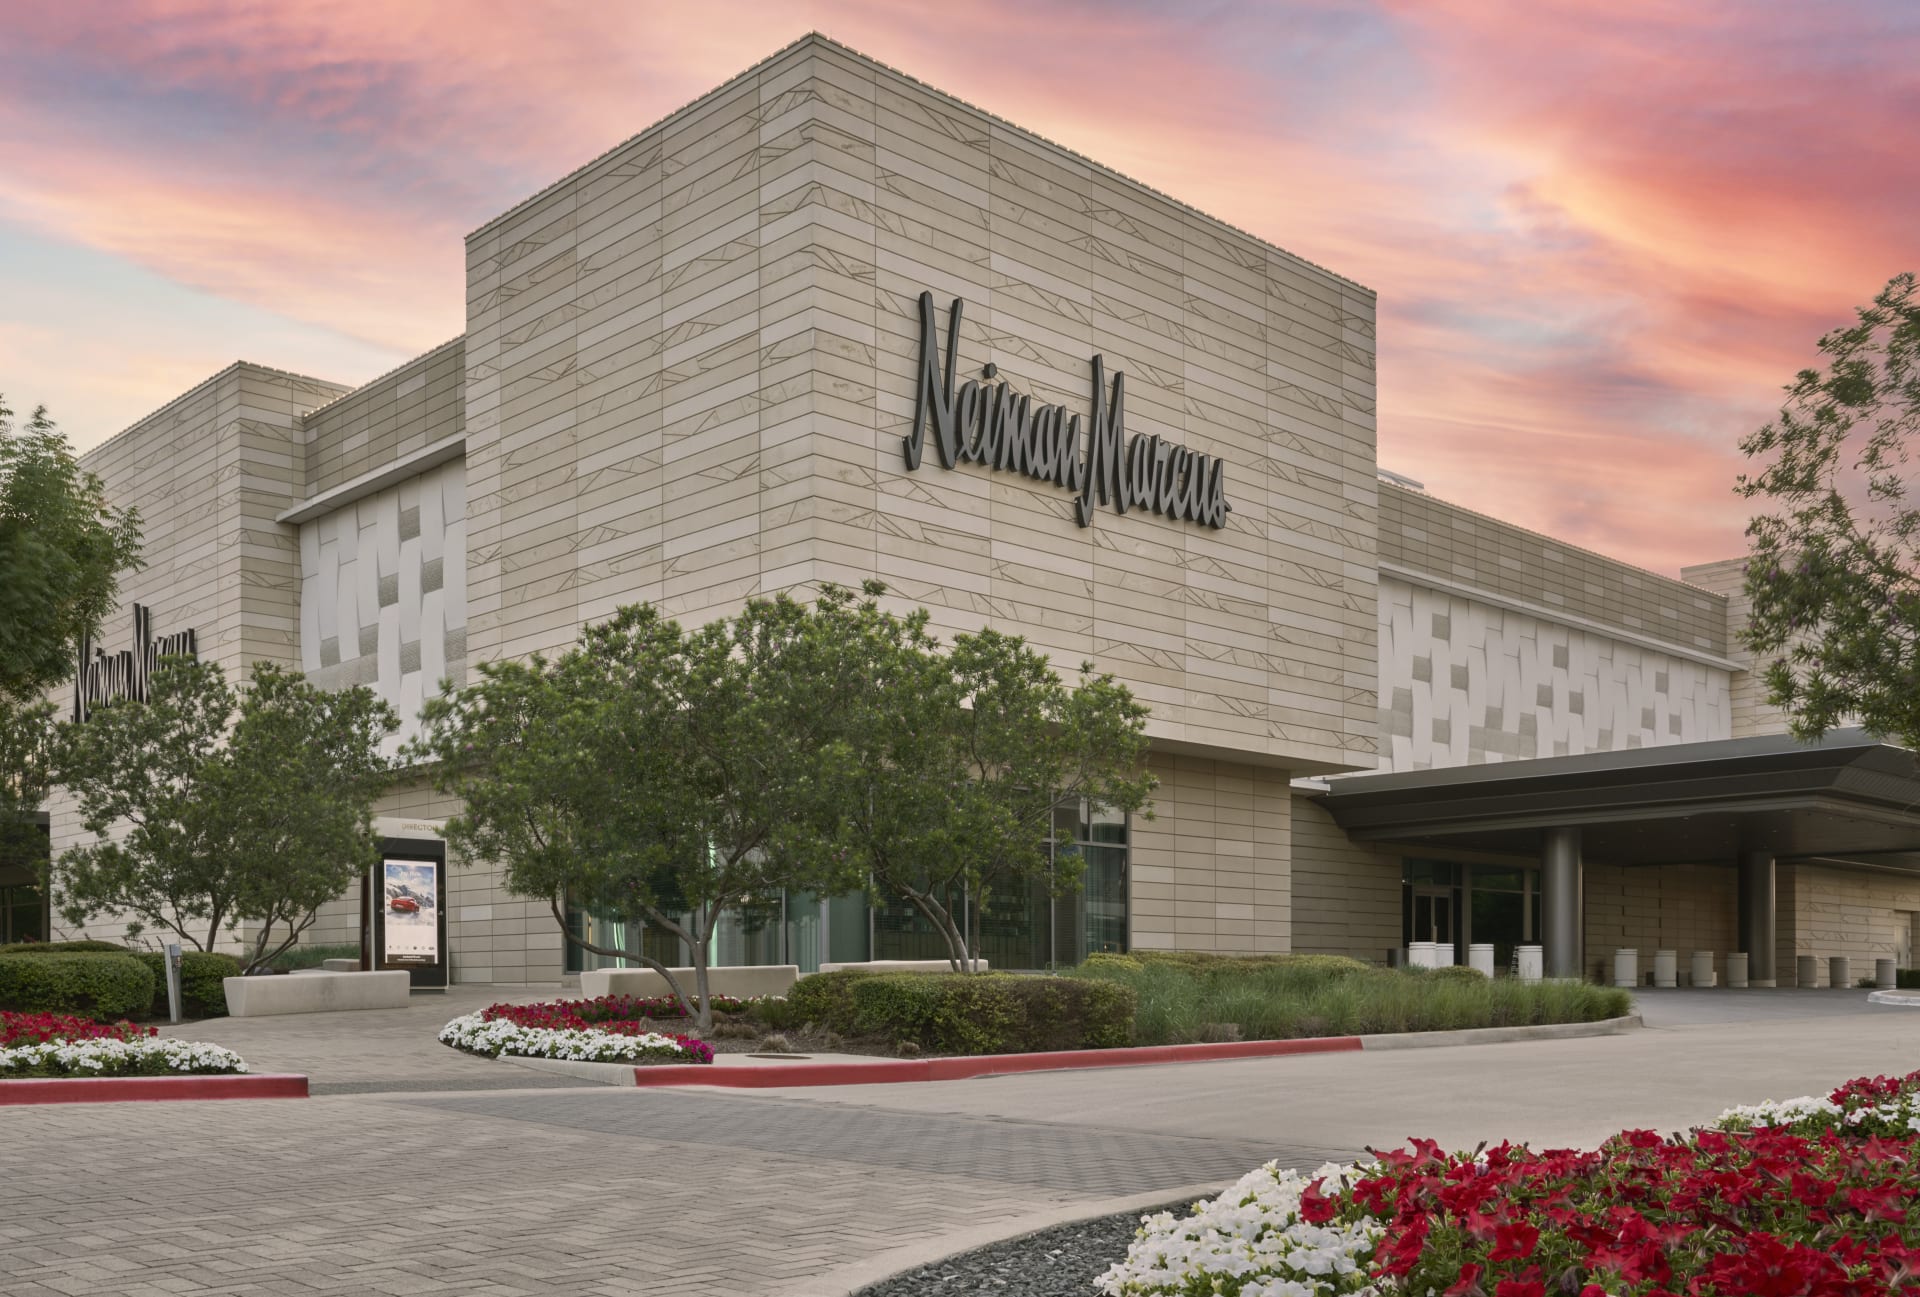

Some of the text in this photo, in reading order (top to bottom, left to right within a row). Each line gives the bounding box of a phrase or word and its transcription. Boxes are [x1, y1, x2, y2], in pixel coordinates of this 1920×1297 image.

[903, 290, 1233, 529] Neiman Marcus
[401, 823, 438, 832] DIRECTO
